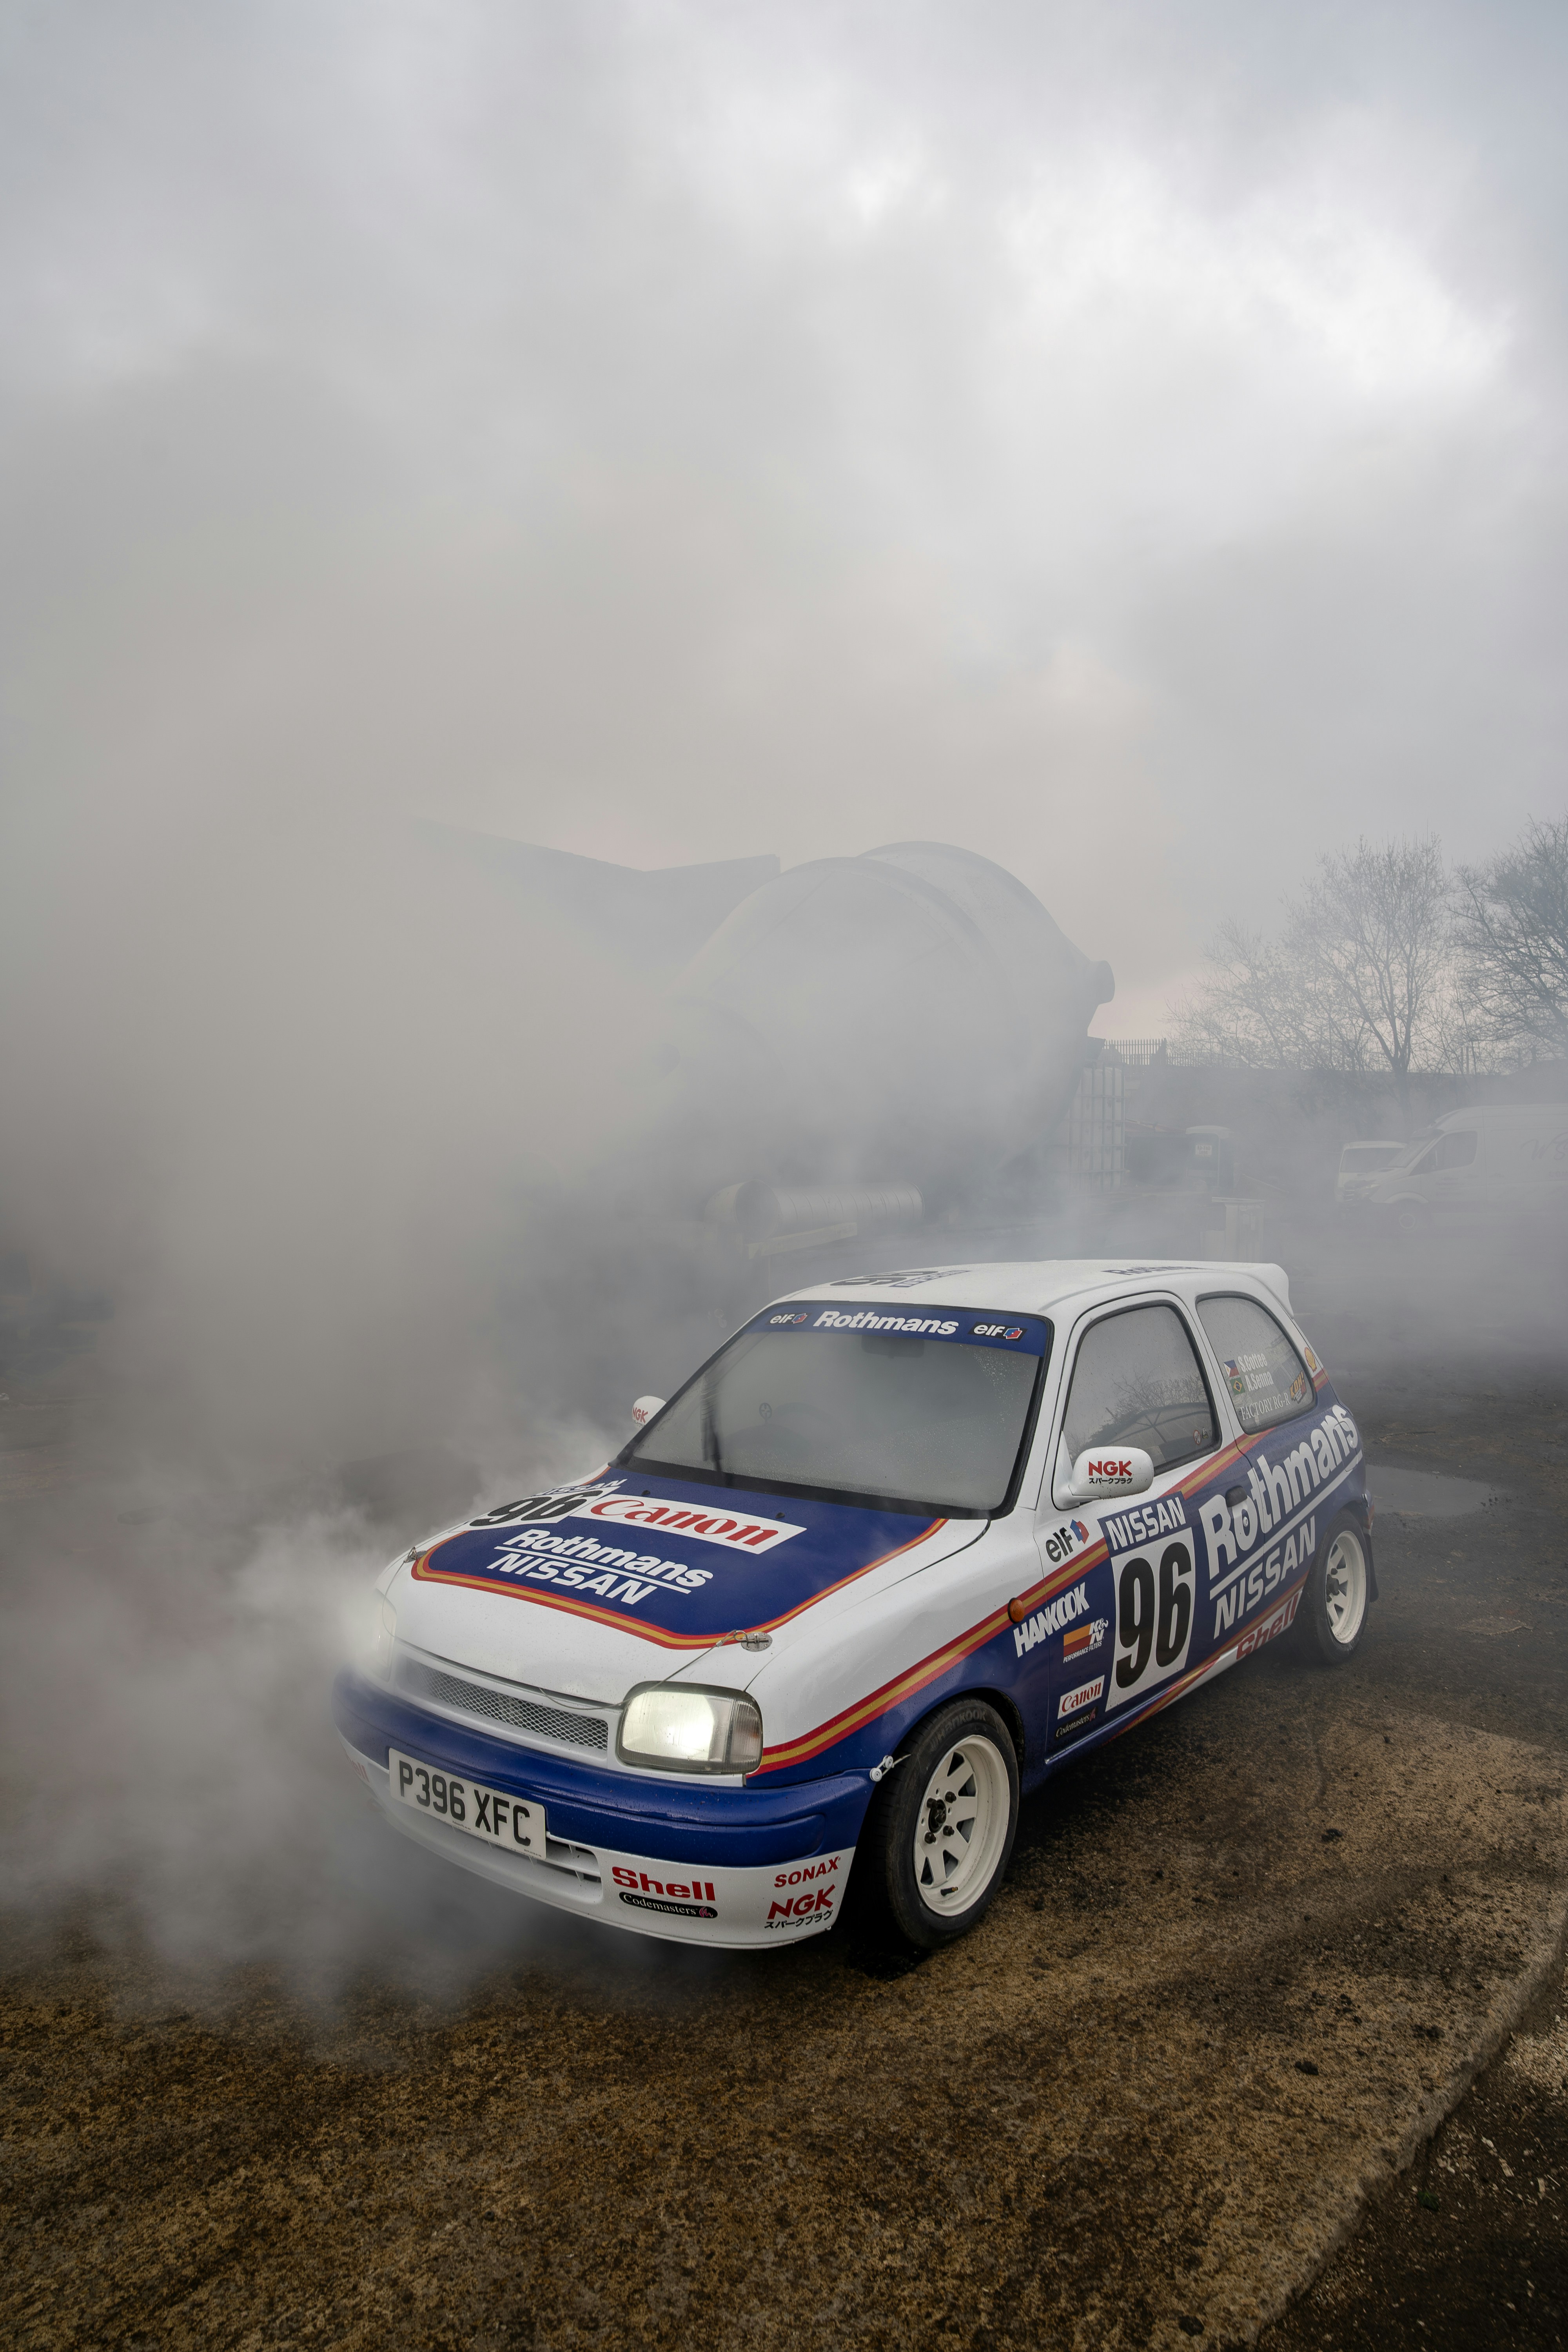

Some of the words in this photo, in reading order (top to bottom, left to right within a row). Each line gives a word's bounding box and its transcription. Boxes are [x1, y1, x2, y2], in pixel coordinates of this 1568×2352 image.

[830, 1270, 939, 1286] 96
[770, 1312, 795, 1324] elf
[813, 1311, 959, 1334] Rothmans
[973, 1322, 1005, 1337] elf
[1238, 1353, 1268, 1373] S.Cottee
[1245, 1371, 1274, 1392] A.Senna
[632, 1406, 648, 1424] NGK
[1240, 1397, 1273, 1420] FACTORY
[1272, 1392, 1290, 1410] RG-R
[1088, 1460, 1132, 1477] NGK
[469, 1490, 603, 1527] 96
[1198, 1405, 1358, 1581] Rothmans
[590, 1499, 779, 1546] Canon
[1105, 1497, 1186, 1551] NISSAN
[503, 1529, 713, 1587] Rothmans
[1045, 1527, 1073, 1563] elf
[486, 1553, 657, 1605] NISSAN
[1214, 1516, 1316, 1639] NISSAN
[1013, 1582, 1090, 1658] HANKOOK
[1115, 1542, 1192, 1689] 96
[1236, 1592, 1299, 1660] Shell
[1063, 1646, 1089, 1664] PERFORMANCE
[1089, 1641, 1102, 1652] FILTERS
[1062, 1682, 1101, 1713] Canon
[1056, 1714, 1090, 1737] Codemasters
[399, 1760, 466, 1822] P396
[474, 1789, 531, 1846] XFC
[612, 1866, 716, 1901] Shell
[774, 1856, 840, 1888] SONAX
[623, 1894, 696, 1915] Codemasters
[767, 1884, 836, 1920] NGK
[764, 1909, 834, 1929] スパークプラグ
